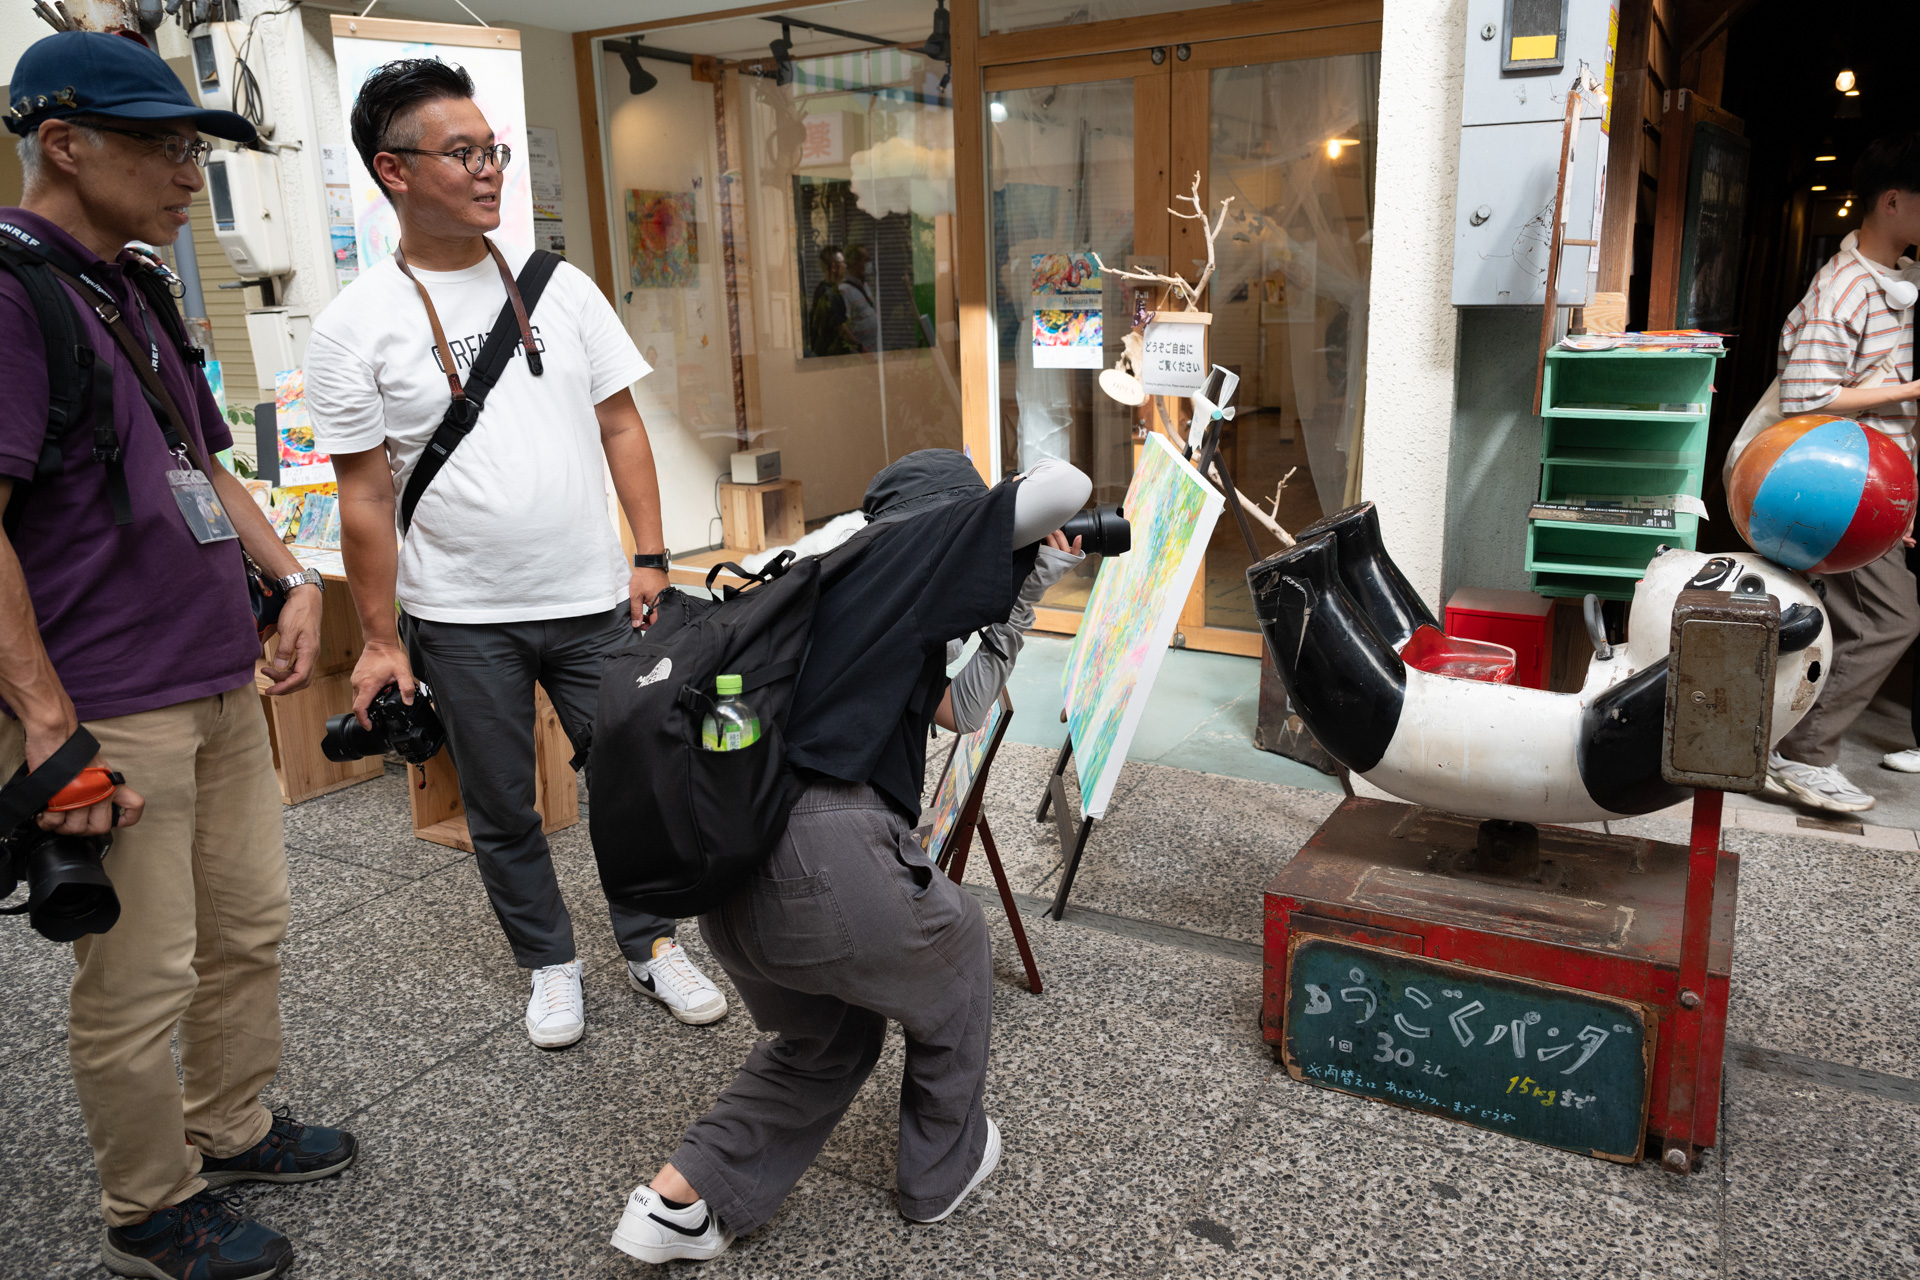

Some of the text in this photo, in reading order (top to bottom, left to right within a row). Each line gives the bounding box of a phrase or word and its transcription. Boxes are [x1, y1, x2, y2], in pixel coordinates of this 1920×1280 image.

[1145, 342, 1193, 355] どうぞご自由に
[1158, 359, 1200, 373] ご覧ください
[1341, 967, 1633, 1075] うごくパンダ
[1373, 1031, 1415, 1067] 30
[1421, 1060, 1449, 1078] えん
[1560, 1088, 1597, 1110] まで
[632, 1192, 651, 1207] NIKE
